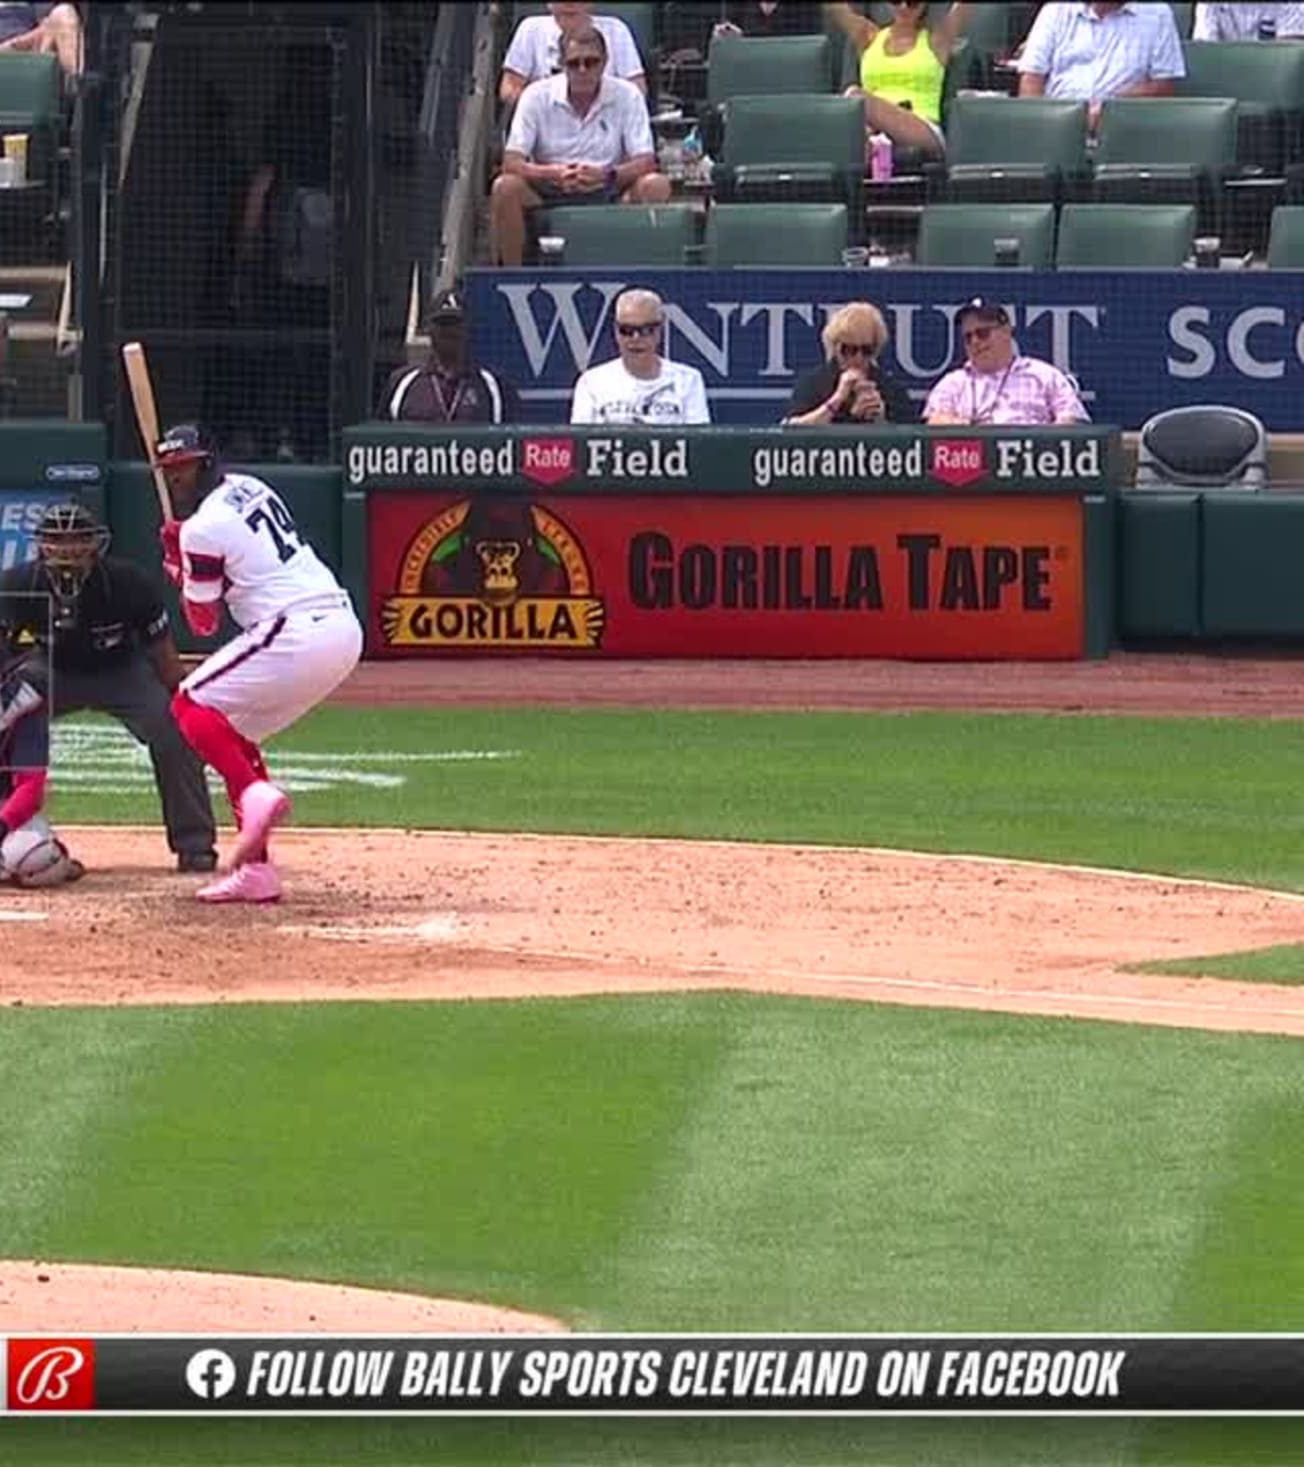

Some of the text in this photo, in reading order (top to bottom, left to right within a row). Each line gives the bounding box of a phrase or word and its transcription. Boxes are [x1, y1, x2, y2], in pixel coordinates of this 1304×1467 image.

[498, 282, 1097, 377] WNTUT
[1167, 305, 1304, 379] SC
[348, 439, 689, 484] guaranteed Rate Field
[754, 440, 1100, 486] guaranteed Rate Field
[627, 529, 884, 612] GORILLA
[897, 534, 1052, 612] TAPE
[409, 603, 578, 640] GORILLA
